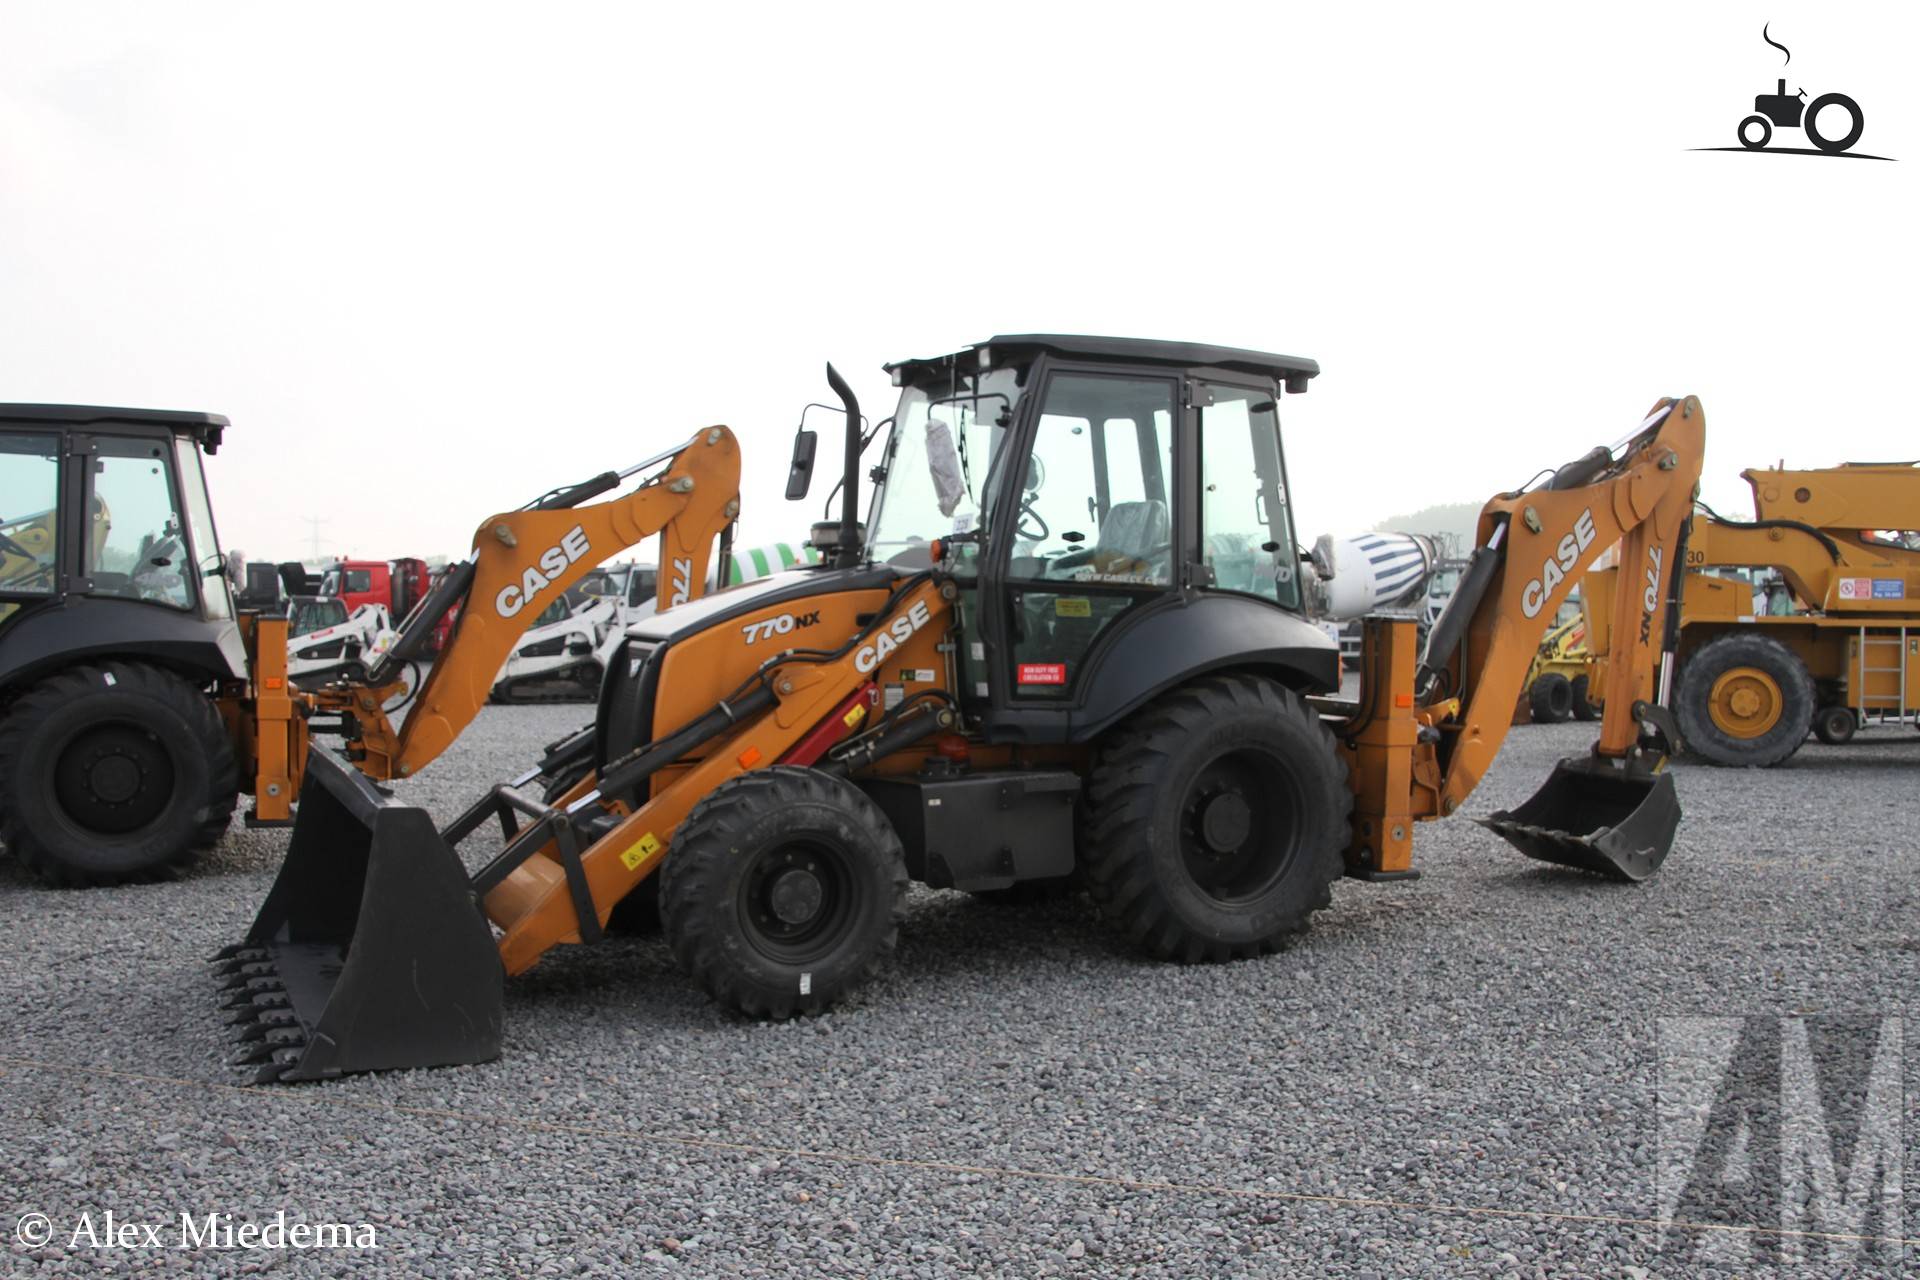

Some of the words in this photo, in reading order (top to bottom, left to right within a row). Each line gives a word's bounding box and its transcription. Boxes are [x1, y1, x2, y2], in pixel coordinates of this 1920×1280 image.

[496, 525, 591, 618] CASE
[1521, 507, 1596, 618] CASE
[1644, 545, 1662, 611] 770
[1687, 550, 1704, 564] 30
[742, 613, 795, 645] 770
[795, 610, 821, 630] NX
[855, 599, 931, 673] CASE
[1640, 611, 1652, 648] NX
